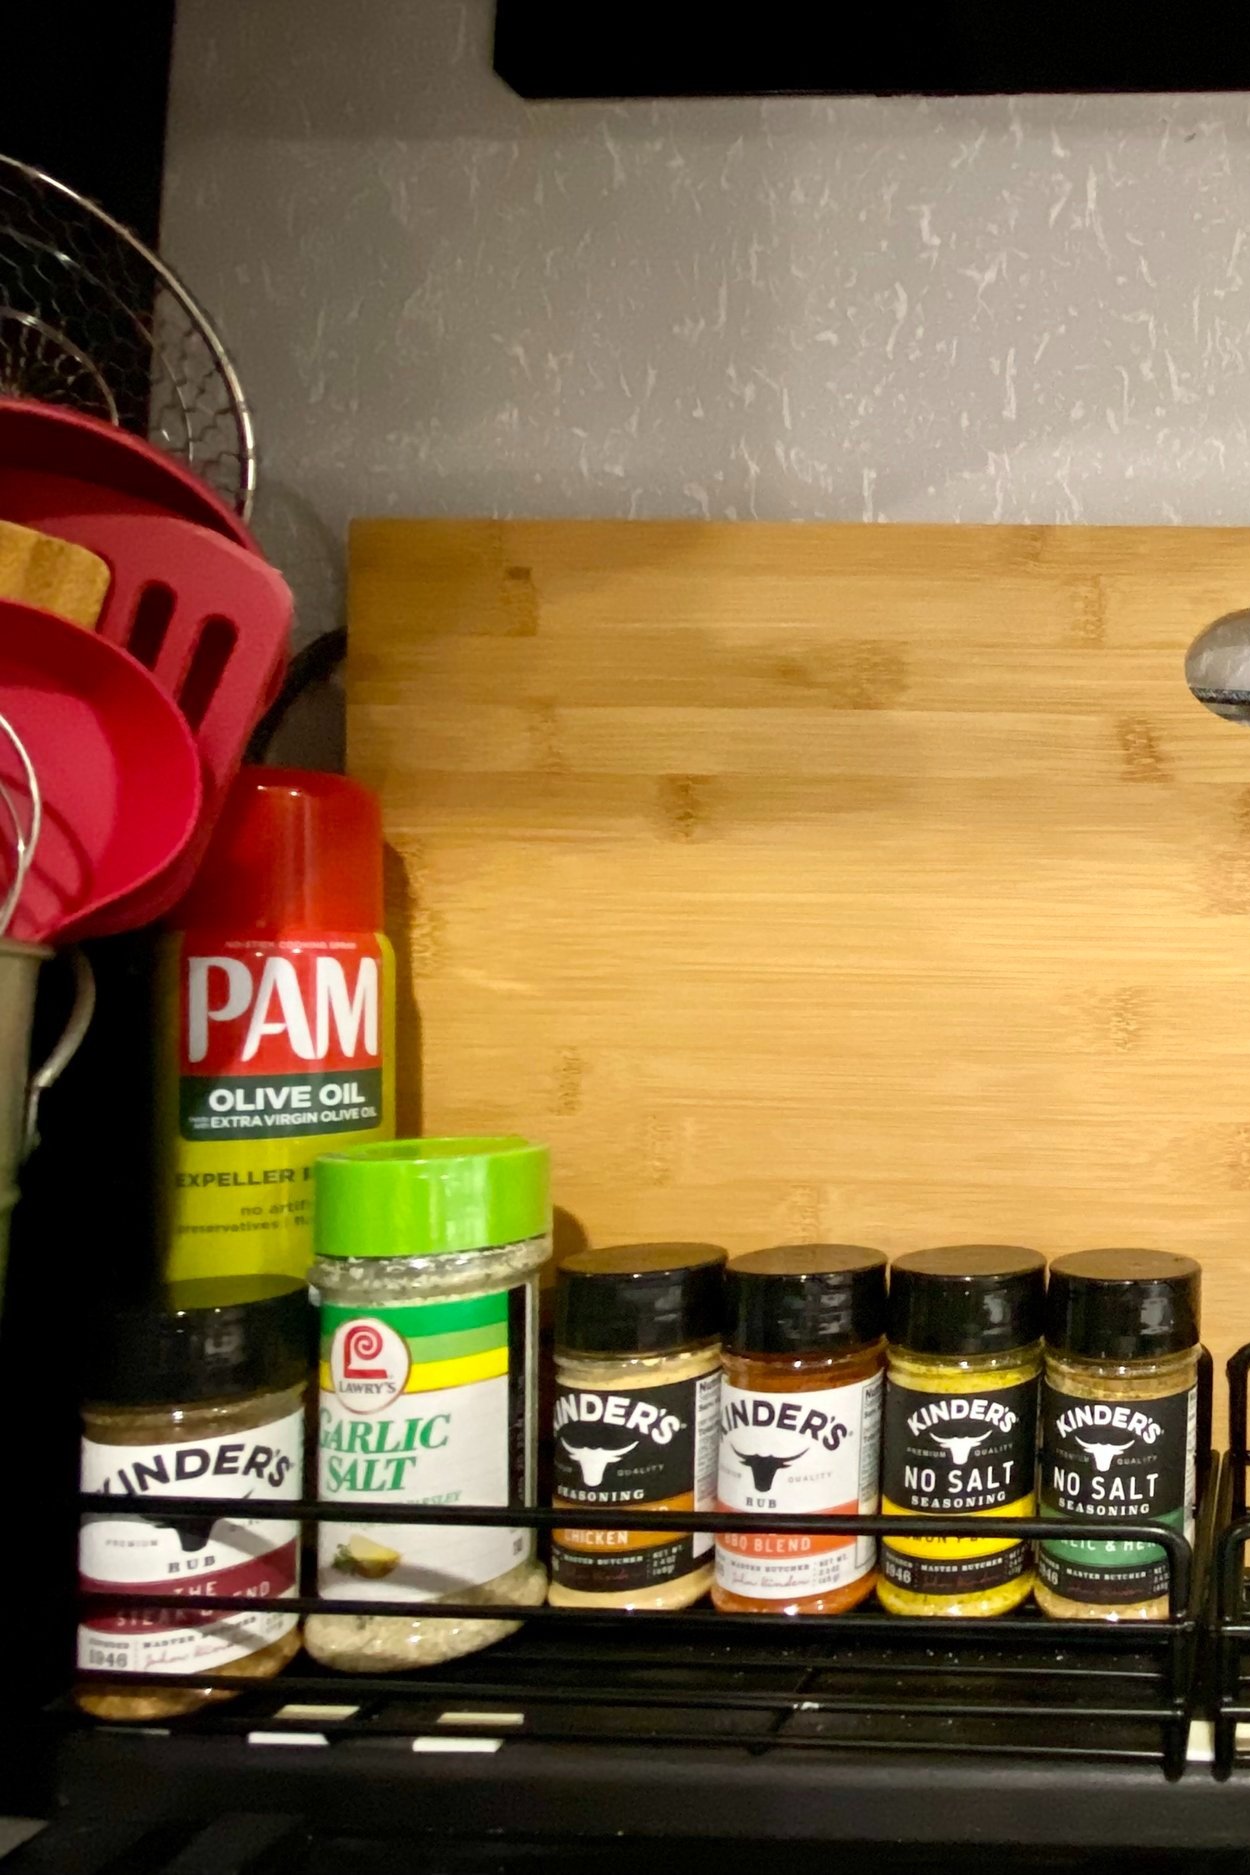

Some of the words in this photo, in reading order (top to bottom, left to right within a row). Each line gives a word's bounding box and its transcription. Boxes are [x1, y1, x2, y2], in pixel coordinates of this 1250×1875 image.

[188, 955, 379, 1063] PAM
[208, 1085, 312, 1112] OLIVE
[318, 1081, 366, 1106] OIL
[210, 1116, 262, 1129] EXTRA
[264, 1111, 318, 1126] VIRGIN
[320, 1107, 359, 1122] OLIVE
[361, 1106, 377, 1118] OIL
[175, 1168, 295, 1188] EXPELLER
[240, 1206, 263, 1216] no
[338, 1381, 396, 1394] LAWRY'S
[907, 1399, 1017, 1437] KINDER'S
[1056, 1404, 1161, 1444] KINDER'S
[974, 1443, 1014, 1457] QUALITY
[1117, 1454, 1158, 1466] QUALITY
[326, 1455, 417, 1493] SALT
[788, 1471, 832, 1483] QUALITY
[905, 1465, 936, 1492] NO
[948, 1461, 1015, 1493] SALT
[1053, 1466, 1081, 1496] NO
[1092, 1473, 1159, 1501] SALT
[745, 1497, 777, 1509] RUB
[911, 1491, 1006, 1508] SEASONING
[1059, 1497, 1150, 1516] SEASONING
[754, 1537, 811, 1553] BLEND
[168, 1555, 216, 1573] RUB
[885, 1561, 912, 1584] 1946
[920, 1564, 959, 1572] MASTER
[961, 1557, 1003, 1572] BUTCHER
[1066, 1568, 1100, 1580] MASTER
[1104, 1571, 1147, 1580] BUTCHER
